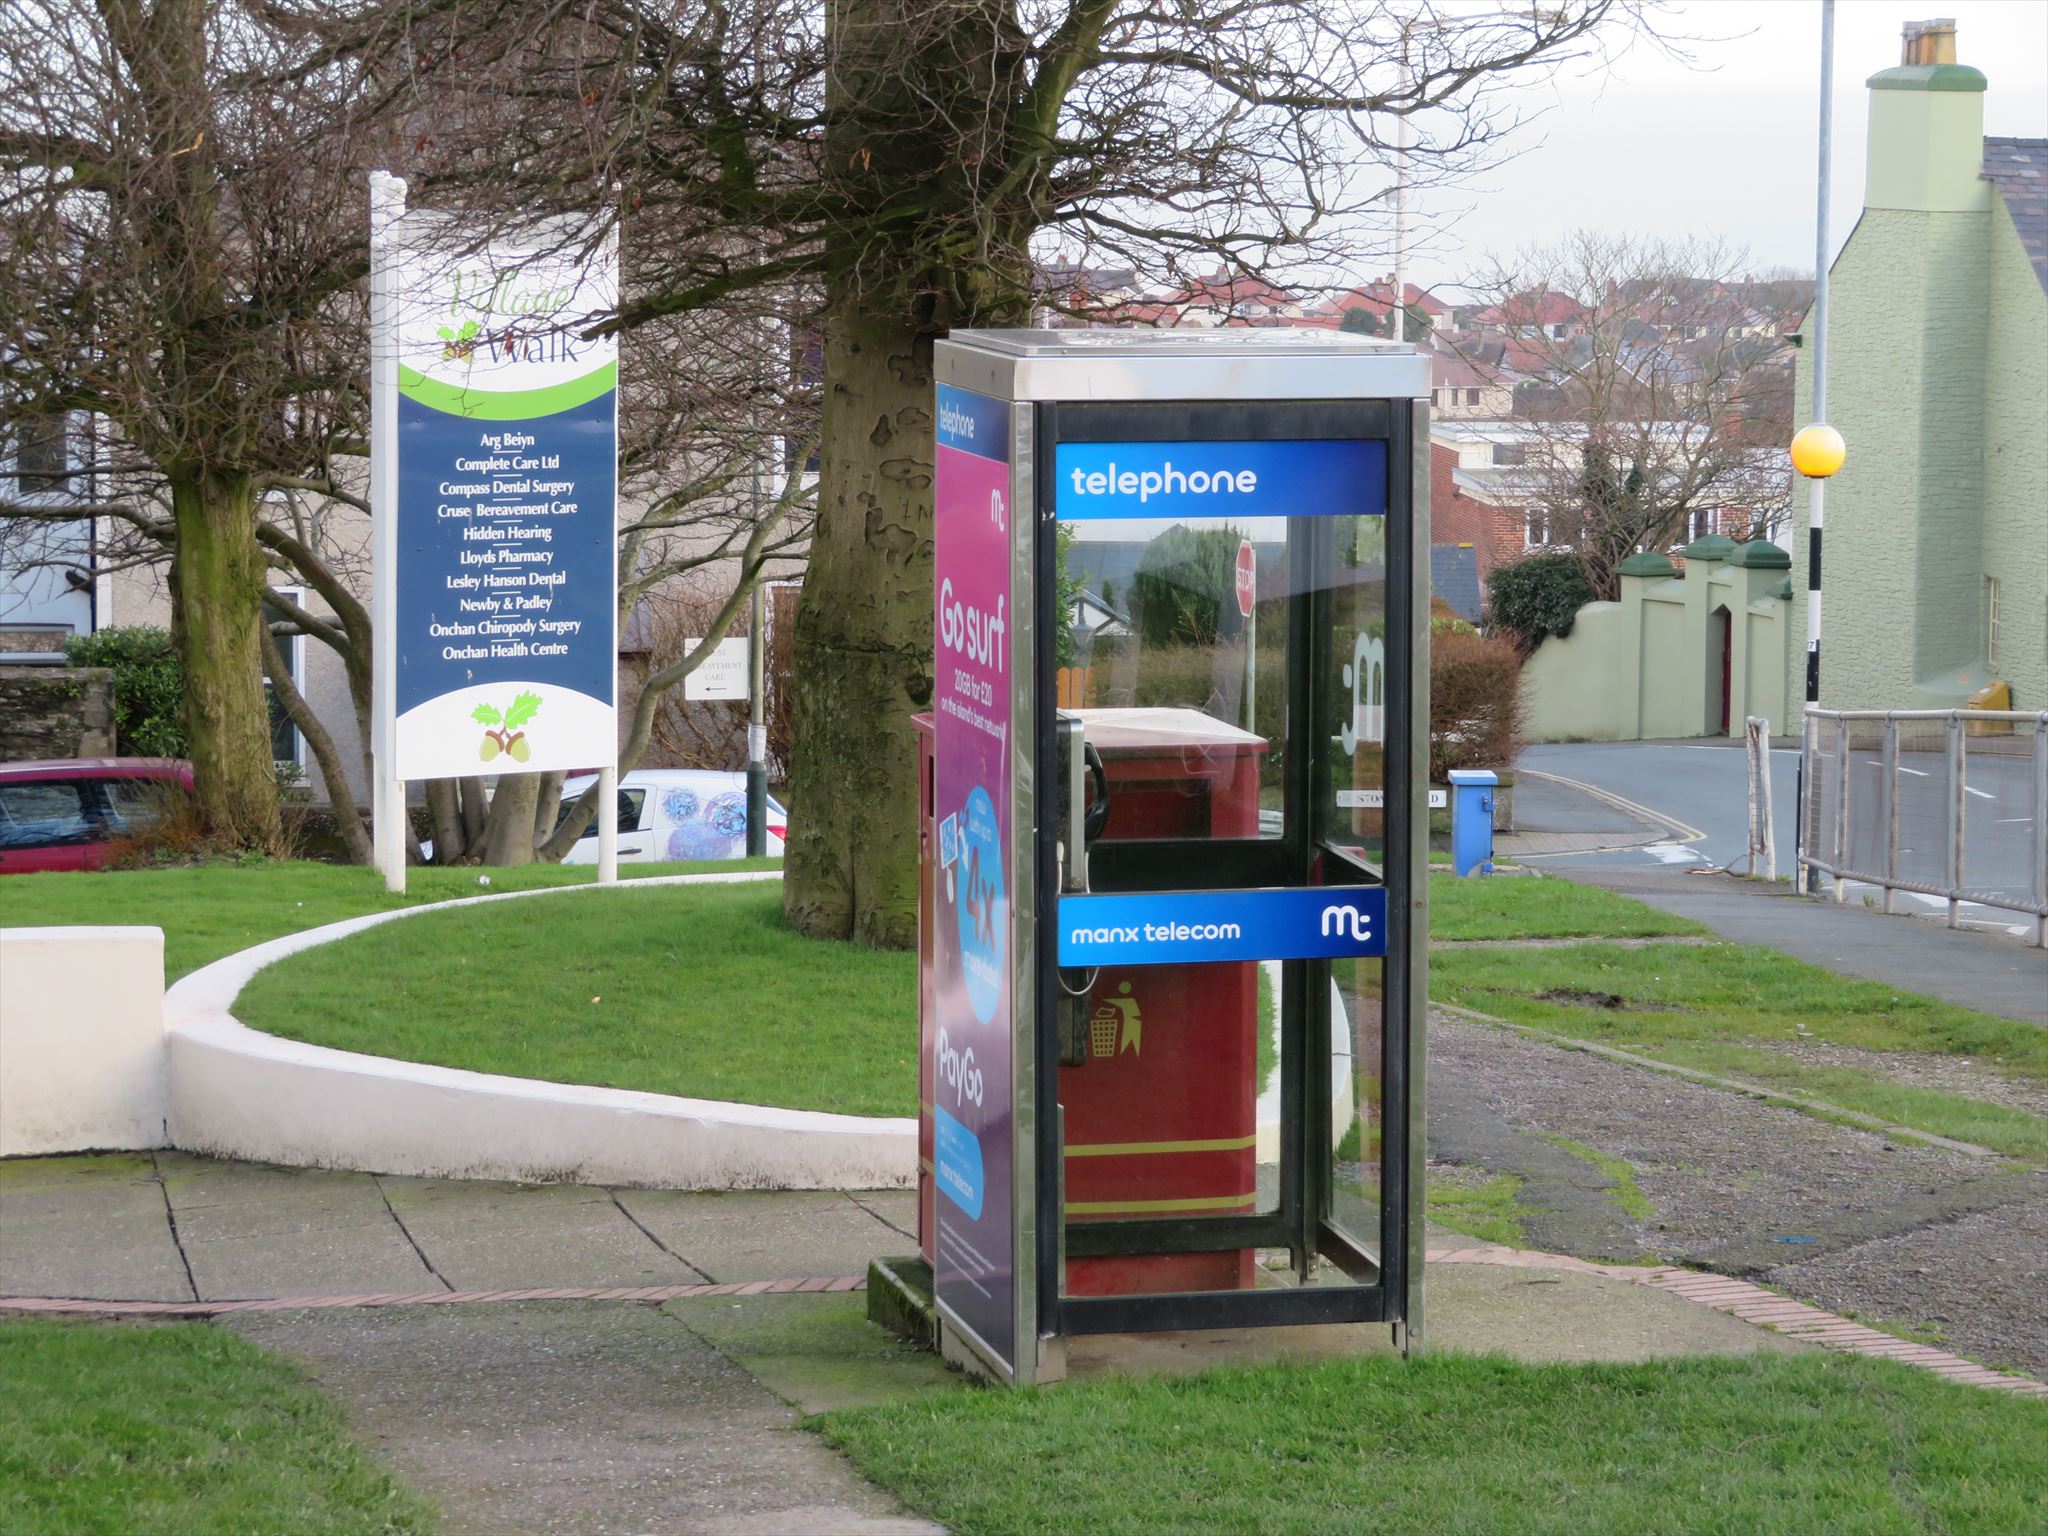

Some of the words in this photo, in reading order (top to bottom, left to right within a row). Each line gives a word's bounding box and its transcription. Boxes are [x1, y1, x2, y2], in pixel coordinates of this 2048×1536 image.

[446, 266, 570, 325] Village
[486, 327, 579, 363] Walk
[940, 402, 975, 440] telephone
[481, 434, 502, 450] Arg
[504, 432, 535, 449] Beiyn
[455, 457, 510, 474] Complete
[513, 456, 539, 470] Care
[542, 455, 560, 469] Ltd
[439, 482, 490, 499] Compass
[493, 479, 531, 494] Dental
[532, 479, 575, 496] Surgery
[1071, 462, 1257, 503] telephone
[437, 504, 471, 518] Cruse
[476, 502, 549, 517] Bereavement
[551, 501, 578, 514] Care
[463, 526, 505, 541] Hidden
[508, 525, 552, 542] Hearing
[460, 550, 496, 567] Lloyds
[499, 550, 554, 566] Pharmacy
[447, 575, 481, 591] Lesley
[483, 572, 526, 587] Hanson
[529, 571, 566, 585] Dental
[1237, 567, 1254, 589] STOP
[460, 597, 501, 614] Newby
[503, 597, 514, 610] &
[515, 595, 552, 612] Padley
[429, 622, 475, 637] Onchan
[478, 620, 537, 637] Chiropody
[539, 619, 581, 635] Surgery
[941, 577, 964, 653] Go
[967, 593, 1005, 673] surf
[443, 645, 488, 660] Onchan
[491, 644, 528, 658] Health
[530, 643, 568, 657] Centre
[972, 674, 980, 701] for
[949, 696, 957, 716] the
[1071, 925, 1139, 945] manx
[1144, 919, 1241, 942] telecom
[940, 1026, 983, 1108] PayGo
